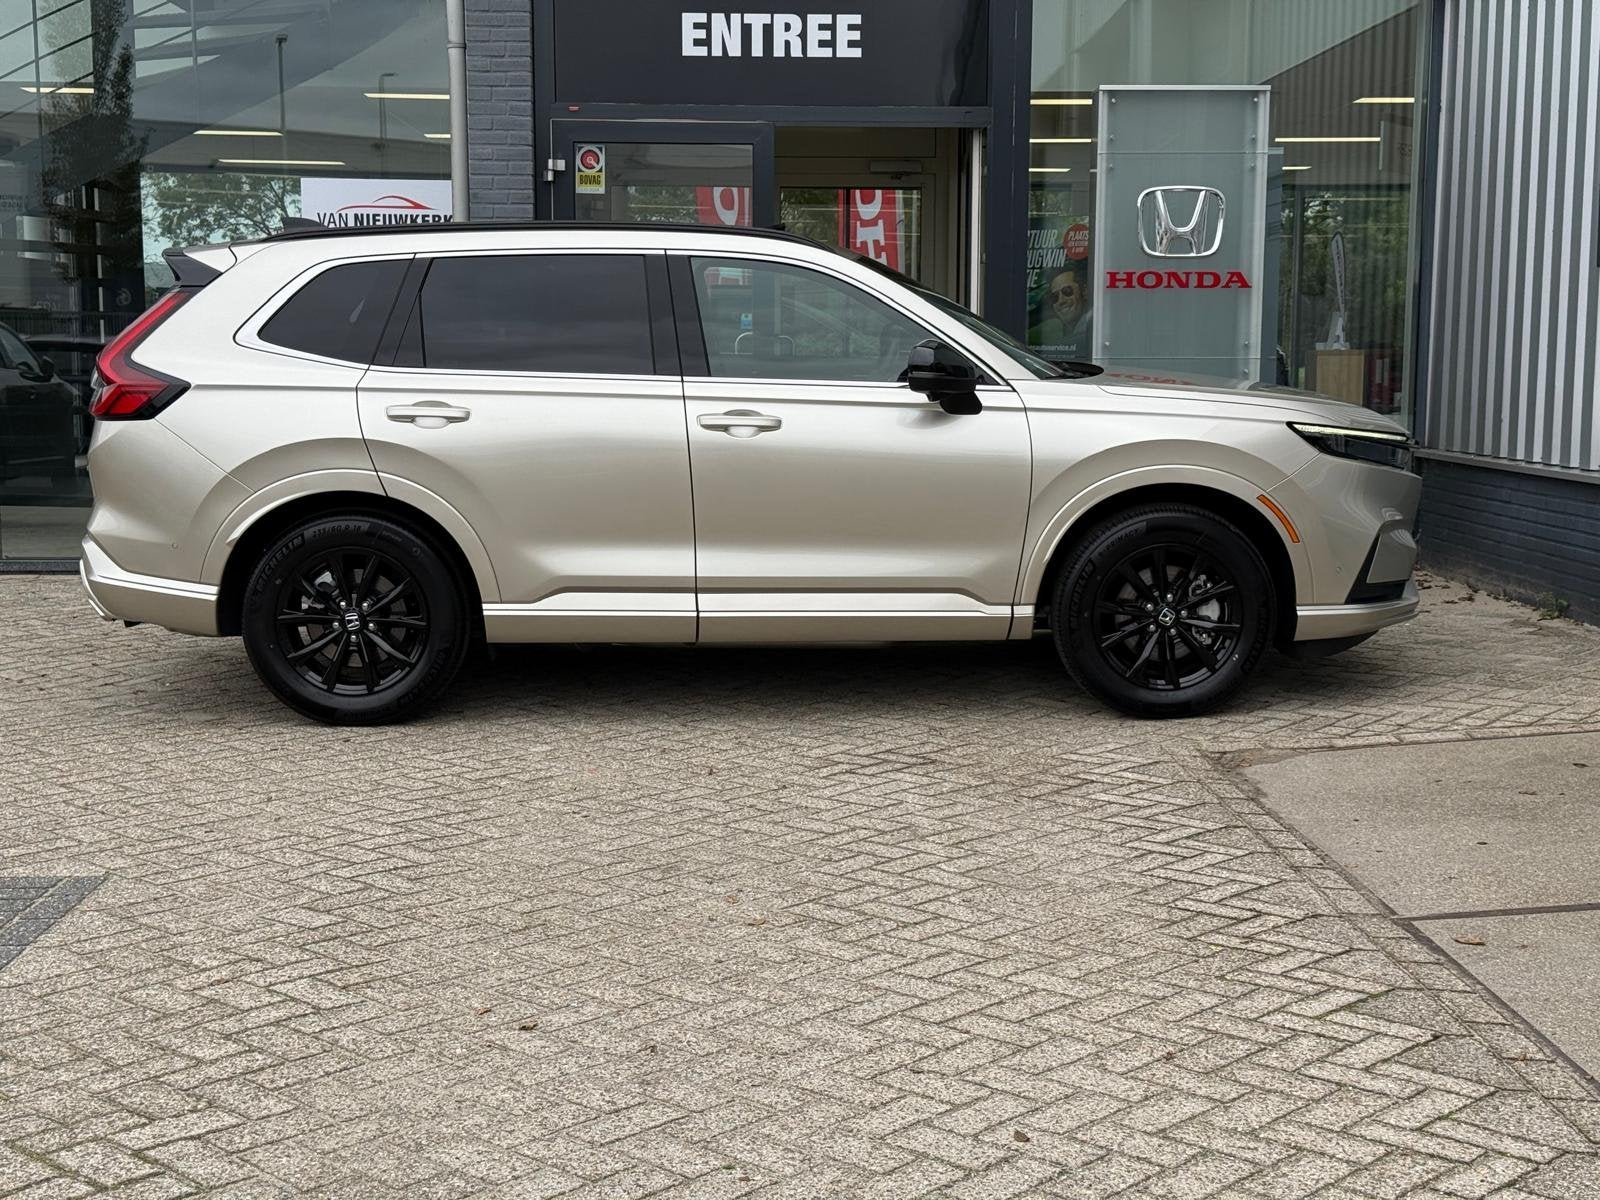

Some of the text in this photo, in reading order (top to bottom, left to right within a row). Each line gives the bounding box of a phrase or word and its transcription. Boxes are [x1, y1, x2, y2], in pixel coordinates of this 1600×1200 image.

[681, 12, 862, 58] ENTREE
[579, 174, 602, 186] BOVAG
[317, 212, 349, 228] VAN
[1027, 229, 1058, 249] TUUR
[1106, 271, 1253, 289] HONDA
